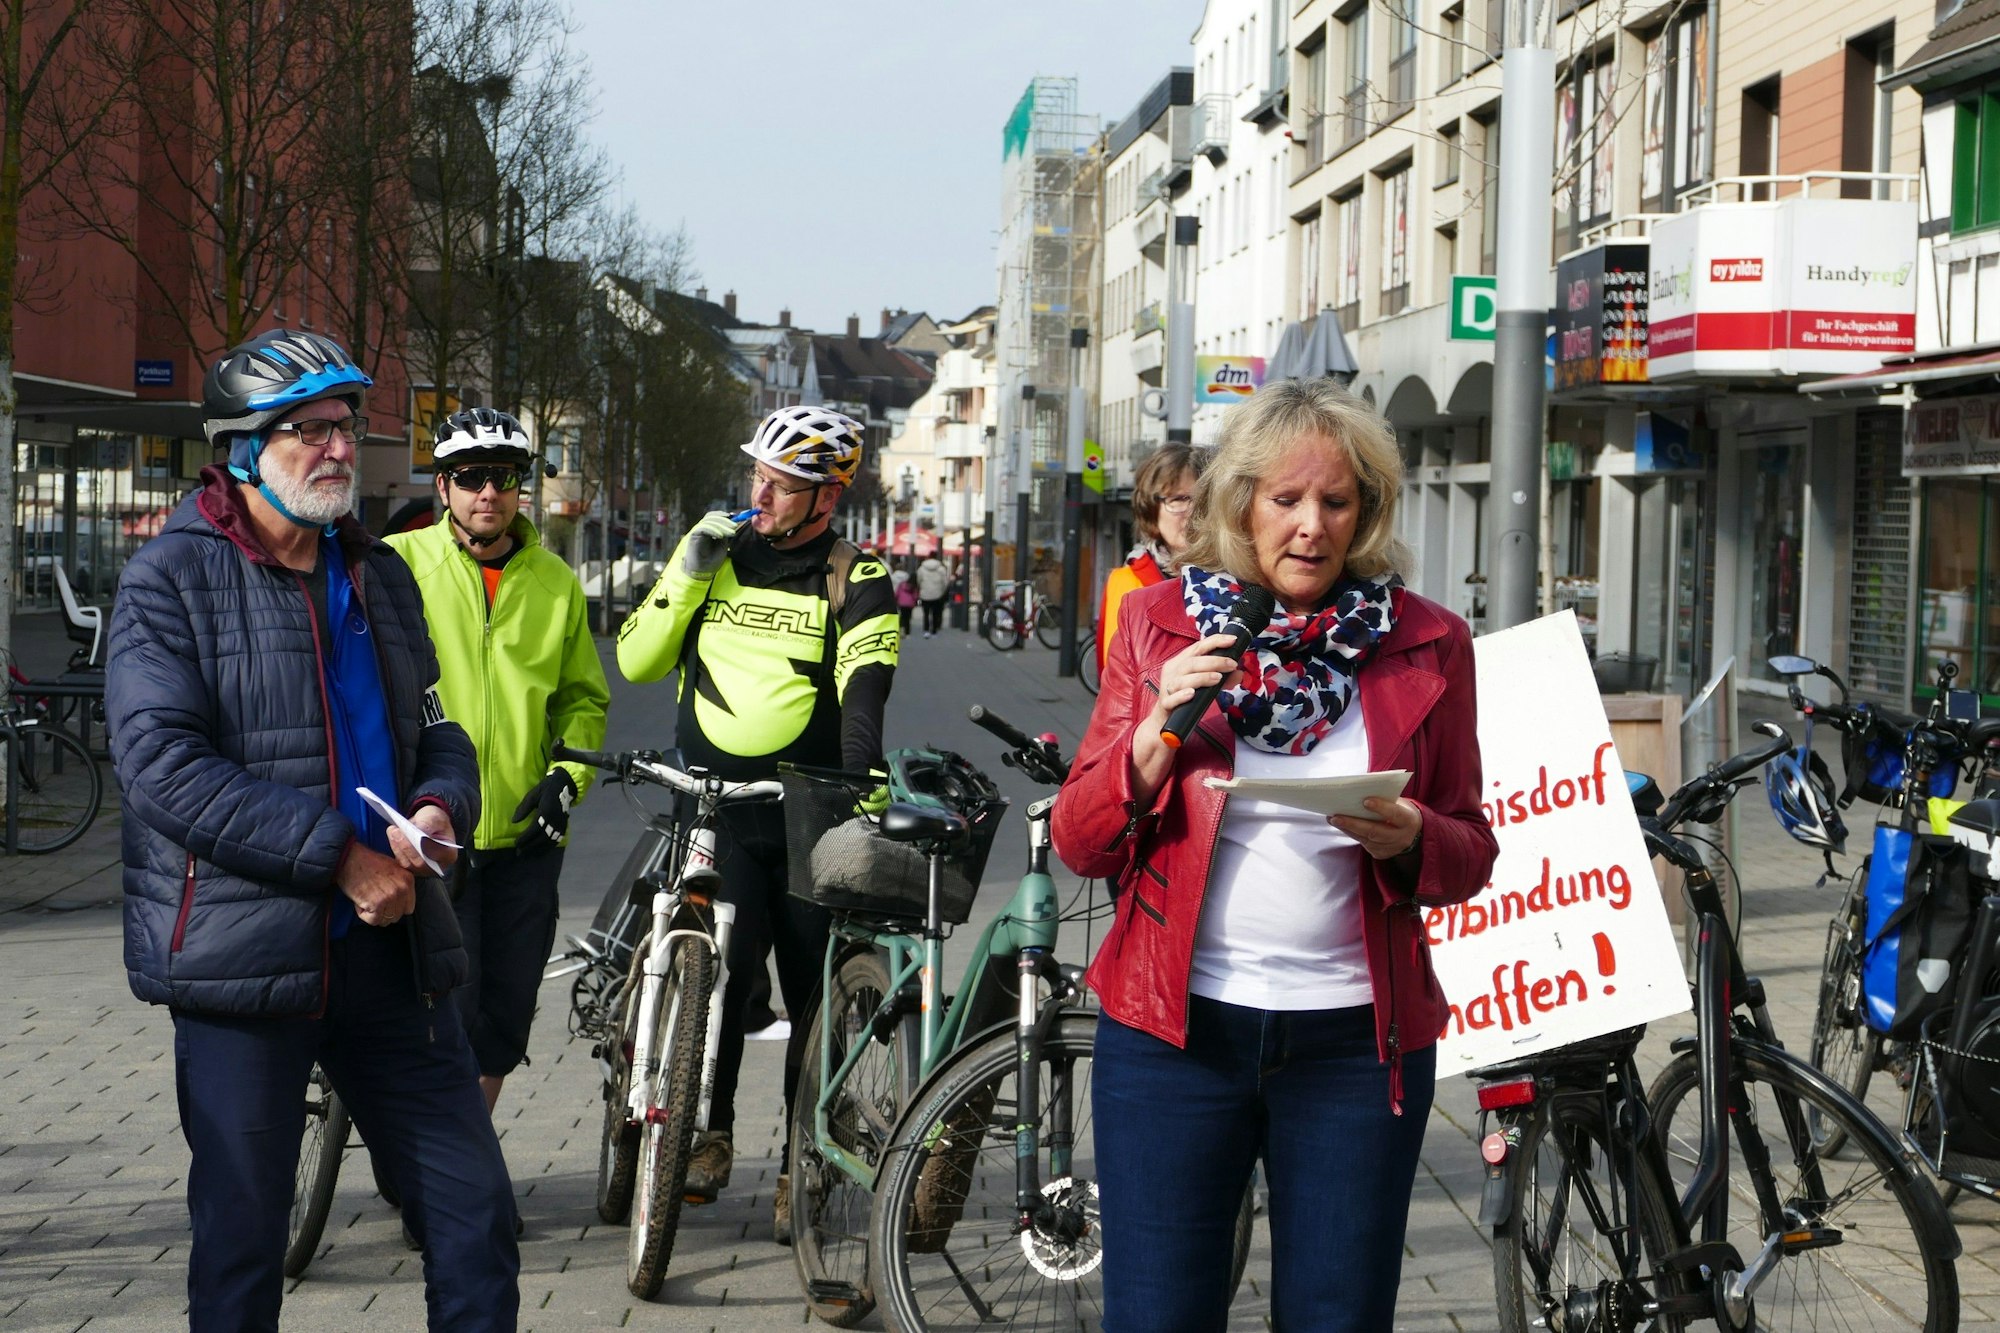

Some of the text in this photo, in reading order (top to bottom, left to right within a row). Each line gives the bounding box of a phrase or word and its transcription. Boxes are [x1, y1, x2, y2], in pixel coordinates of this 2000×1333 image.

[1834, 319, 1898, 333] Fachgeschäft
[1802, 331, 1914, 347] für Handyreparaturen
[1215, 364, 1249, 384] dm
[751, 630, 778, 641] RACING
